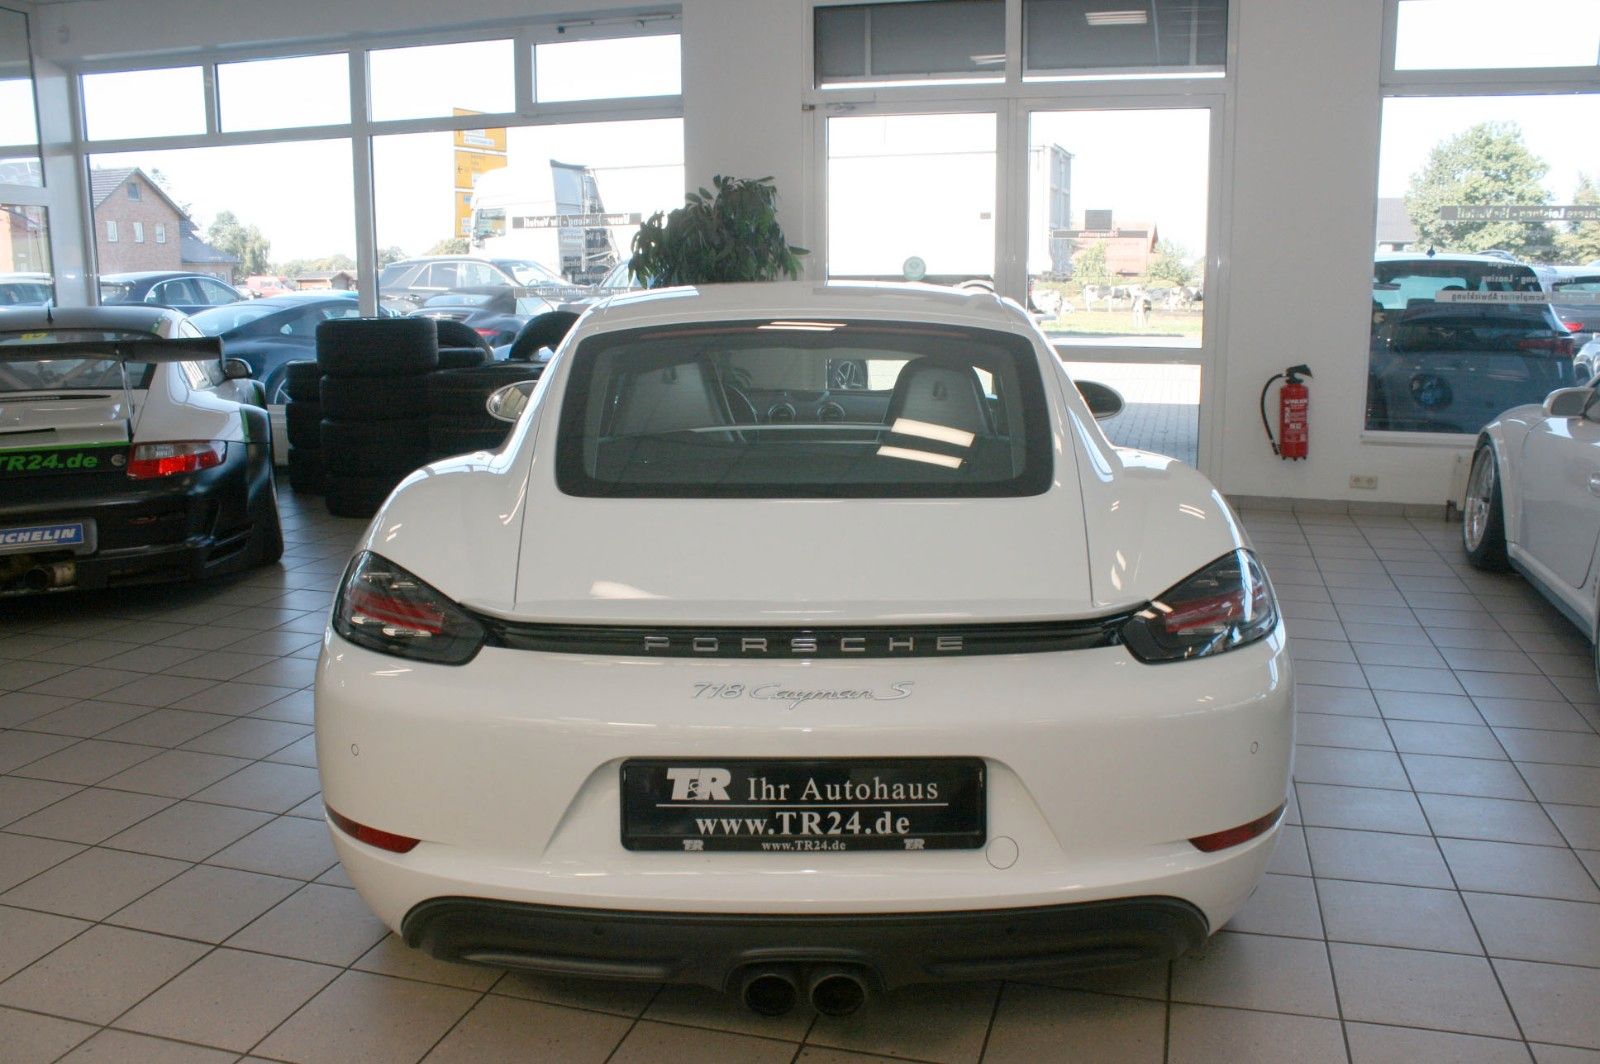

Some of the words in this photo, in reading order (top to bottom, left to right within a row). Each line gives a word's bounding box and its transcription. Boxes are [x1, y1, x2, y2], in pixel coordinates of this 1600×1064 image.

[0, 528, 76, 544] ICHELIN
[644, 636, 963, 652] PORSCHE
[693, 684, 745, 699] 718
[749, 683, 873, 710] Cayman
[876, 682, 914, 700] S
[747, 777, 790, 800] Ihr
[800, 777, 939, 800] Autohaus
[695, 811, 910, 835] www.TR24.de
[762, 840, 846, 851] www.TR24.de
